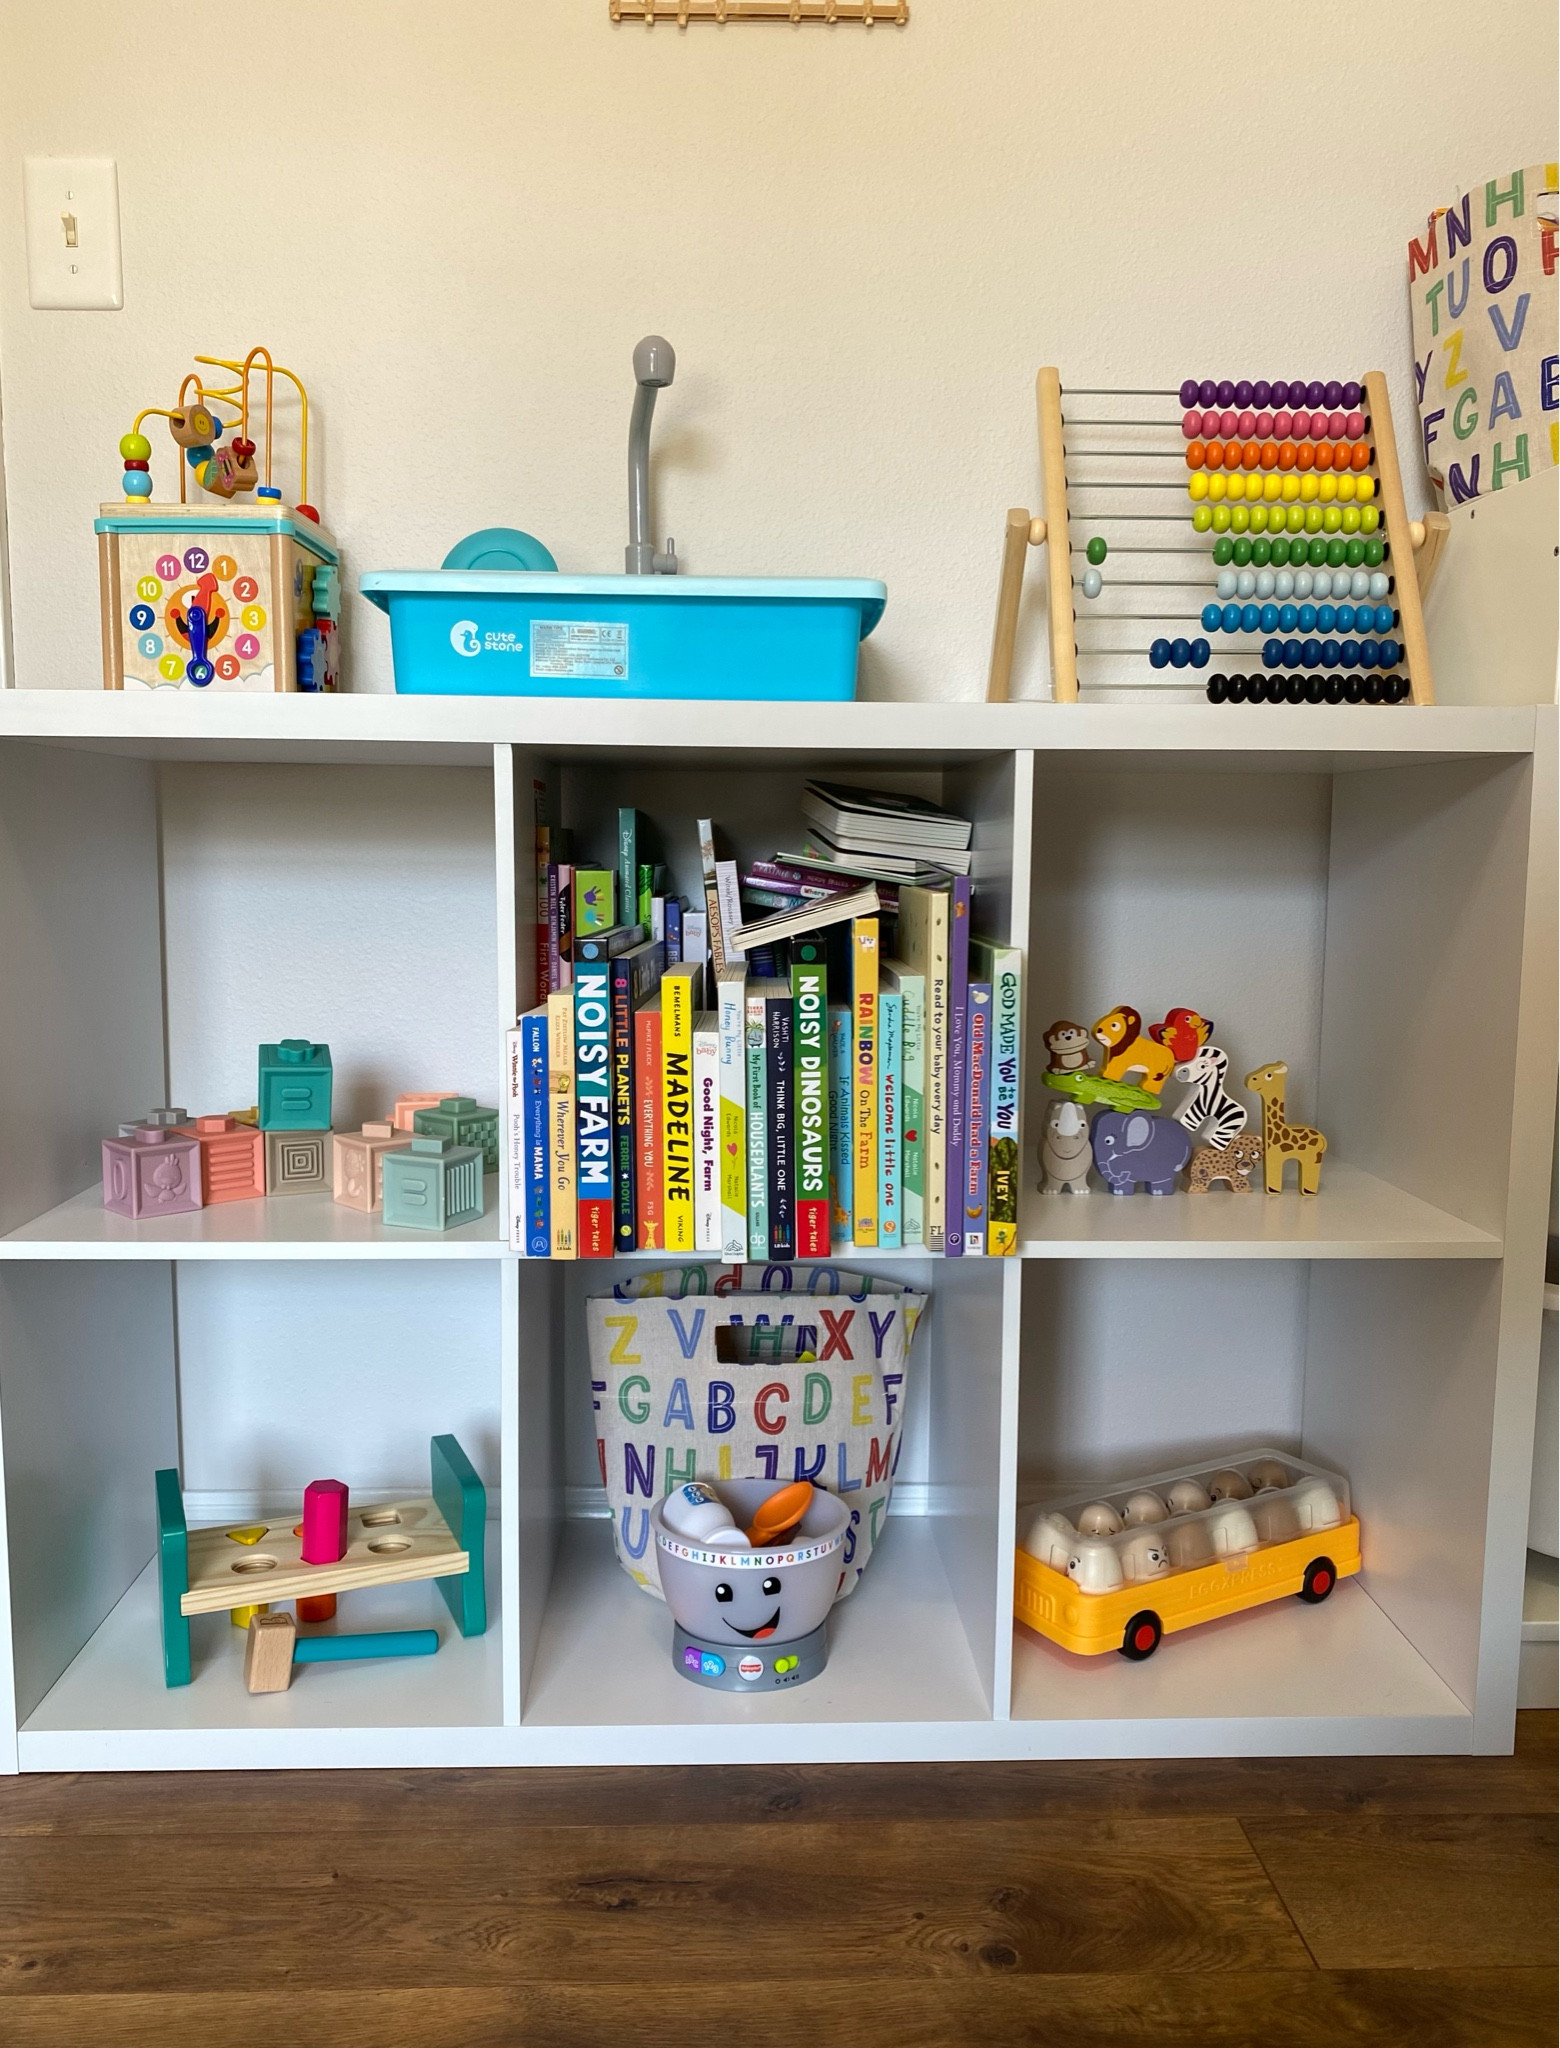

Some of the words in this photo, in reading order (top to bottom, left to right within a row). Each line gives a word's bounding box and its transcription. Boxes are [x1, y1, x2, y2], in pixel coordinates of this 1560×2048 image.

[1408, 229, 1438, 282] M
[1446, 193, 1472, 259] N
[1486, 170, 1525, 227] H
[1426, 279, 1444, 336] T
[1447, 258, 1470, 319] U
[1483, 236, 1517, 294] O
[1443, 329, 1468, 391] Z
[1488, 293, 1531, 351] V
[1453, 387, 1478, 440] G
[1488, 371, 1522, 430] A
[1492, 433, 1531, 491] H
[161, 562, 175, 576] 11
[189, 554, 204, 569] 12
[140, 582, 157, 596] 10
[241, 583, 250, 596] 2
[137, 611, 147, 625] 9
[249, 611, 259, 625] 3
[146, 639, 155, 653] 8
[242, 640, 252, 654] 4
[485, 642, 523, 652] stone
[486, 632, 516, 642] cute
[167, 661, 176, 674] 7
[223, 661, 232, 675] 5
[621, 829, 632, 856] Disney
[558, 897, 566, 913] Tyler
[624, 889, 632, 913] Classics
[539, 943, 548, 965] First
[712, 940, 724, 974] FABLES
[614, 978, 627, 988] 8
[934, 979, 944, 1009] Read
[1001, 972, 1016, 1010] GOD
[616, 995, 629, 1047] LITTLE
[673, 985, 682, 1037] BEMELMANS
[722, 1002, 736, 1031] Honey
[799, 976, 821, 1048] NOISY
[934, 1012, 943, 1024] to
[954, 1013, 962, 1035] Love
[576, 974, 608, 1087] NOISY
[772, 1011, 781, 1048] HARRISON
[781, 1017, 789, 1043] VASHTI
[859, 993, 873, 1084] RAINBOW
[972, 1014, 984, 1037] Old
[1001, 1012, 1016, 1053] MADE
[532, 1027, 540, 1052] FALLON
[696, 1047, 718, 1056] baby
[722, 1035, 738, 1065] Bunny
[930, 1027, 943, 1051] your
[953, 1036, 962, 1057] You,
[751, 1054, 760, 1064] My
[931, 1054, 943, 1079] baby
[998, 1058, 1016, 1082] YOU
[752, 1065, 761, 1082] First
[840, 1076, 850, 1086] If
[952, 1061, 962, 1097] Mommy
[970, 1040, 983, 1118] MacDonald
[617, 1053, 630, 1125] PLANETS
[703, 1077, 713, 1113] Good
[752, 1083, 761, 1100] Book
[777, 1080, 786, 1110] THINK
[860, 1090, 870, 1105] On
[930, 1082, 942, 1111] every
[998, 1086, 1008, 1101] BE
[1008, 1087, 1015, 1099] to
[753, 1101, 762, 1109] of
[828, 1091, 838, 1119] Good
[840, 1088, 849, 1129] Animals
[884, 1074, 895, 1134] welcome
[953, 1100, 962, 1115] and
[997, 1103, 1014, 1129] YOU
[513, 1114, 521, 1135] Pooh's
[534, 1100, 543, 1137] Everything
[556, 1101, 569, 1149] Wherever
[643, 1099, 654, 1147] EVERYTHING
[666, 1052, 690, 1201] MADELINE
[776, 1113, 786, 1132] BIG,
[801, 1057, 823, 1191] DINOSAURS
[860, 1109, 870, 1128] The
[931, 1114, 944, 1134] day
[579, 1095, 609, 1183] FARM
[702, 1115, 714, 1156] Night,
[950, 1118, 961, 1147] Daddy
[970, 1121, 982, 1145] had
[512, 1137, 522, 1160] Honey
[620, 1135, 630, 1170] FERRIE
[643, 1152, 655, 1168] YOU
[750, 1112, 765, 1207] HOUSEPLANTS
[777, 1135, 786, 1166] LITTLE
[840, 1130, 850, 1165] Kissed
[860, 1131, 872, 1169] Farm
[885, 1138, 895, 1176] little
[970, 1148, 979, 1158] a
[534, 1147, 544, 1180] MAMA
[555, 1151, 569, 1173] You
[514, 1163, 522, 1190] Trouble
[557, 1177, 570, 1191] Go
[704, 1159, 713, 1192] Farm
[777, 1169, 787, 1191] ONE
[969, 1161, 981, 1195] Farm
[996, 1170, 1010, 1202] IVEY
[621, 1181, 630, 1214] DOYLE
[885, 1183, 894, 1206] one
[590, 1206, 602, 1228] tiger
[808, 1207, 818, 1229] tiger
[592, 1230, 602, 1252] tales
[809, 1230, 819, 1252] tales
[605, 1315, 642, 1365] Z
[667, 1309, 705, 1359] V
[818, 1310, 855, 1361] X
[869, 1311, 896, 1358] Y
[618, 1375, 651, 1425] G
[663, 1378, 695, 1430] A
[708, 1380, 736, 1434] B
[753, 1382, 790, 1435] C
[803, 1372, 832, 1426] D
[851, 1375, 873, 1426] E
[883, 1374, 903, 1426] F
[625, 1443, 655, 1498] N
[794, 1444, 827, 1490] K
[838, 1442, 862, 1493] L
[866, 1432, 894, 1488] M
[622, 1507, 649, 1559] U
[843, 1510, 860, 1564] S
[869, 1497, 885, 1547] T
